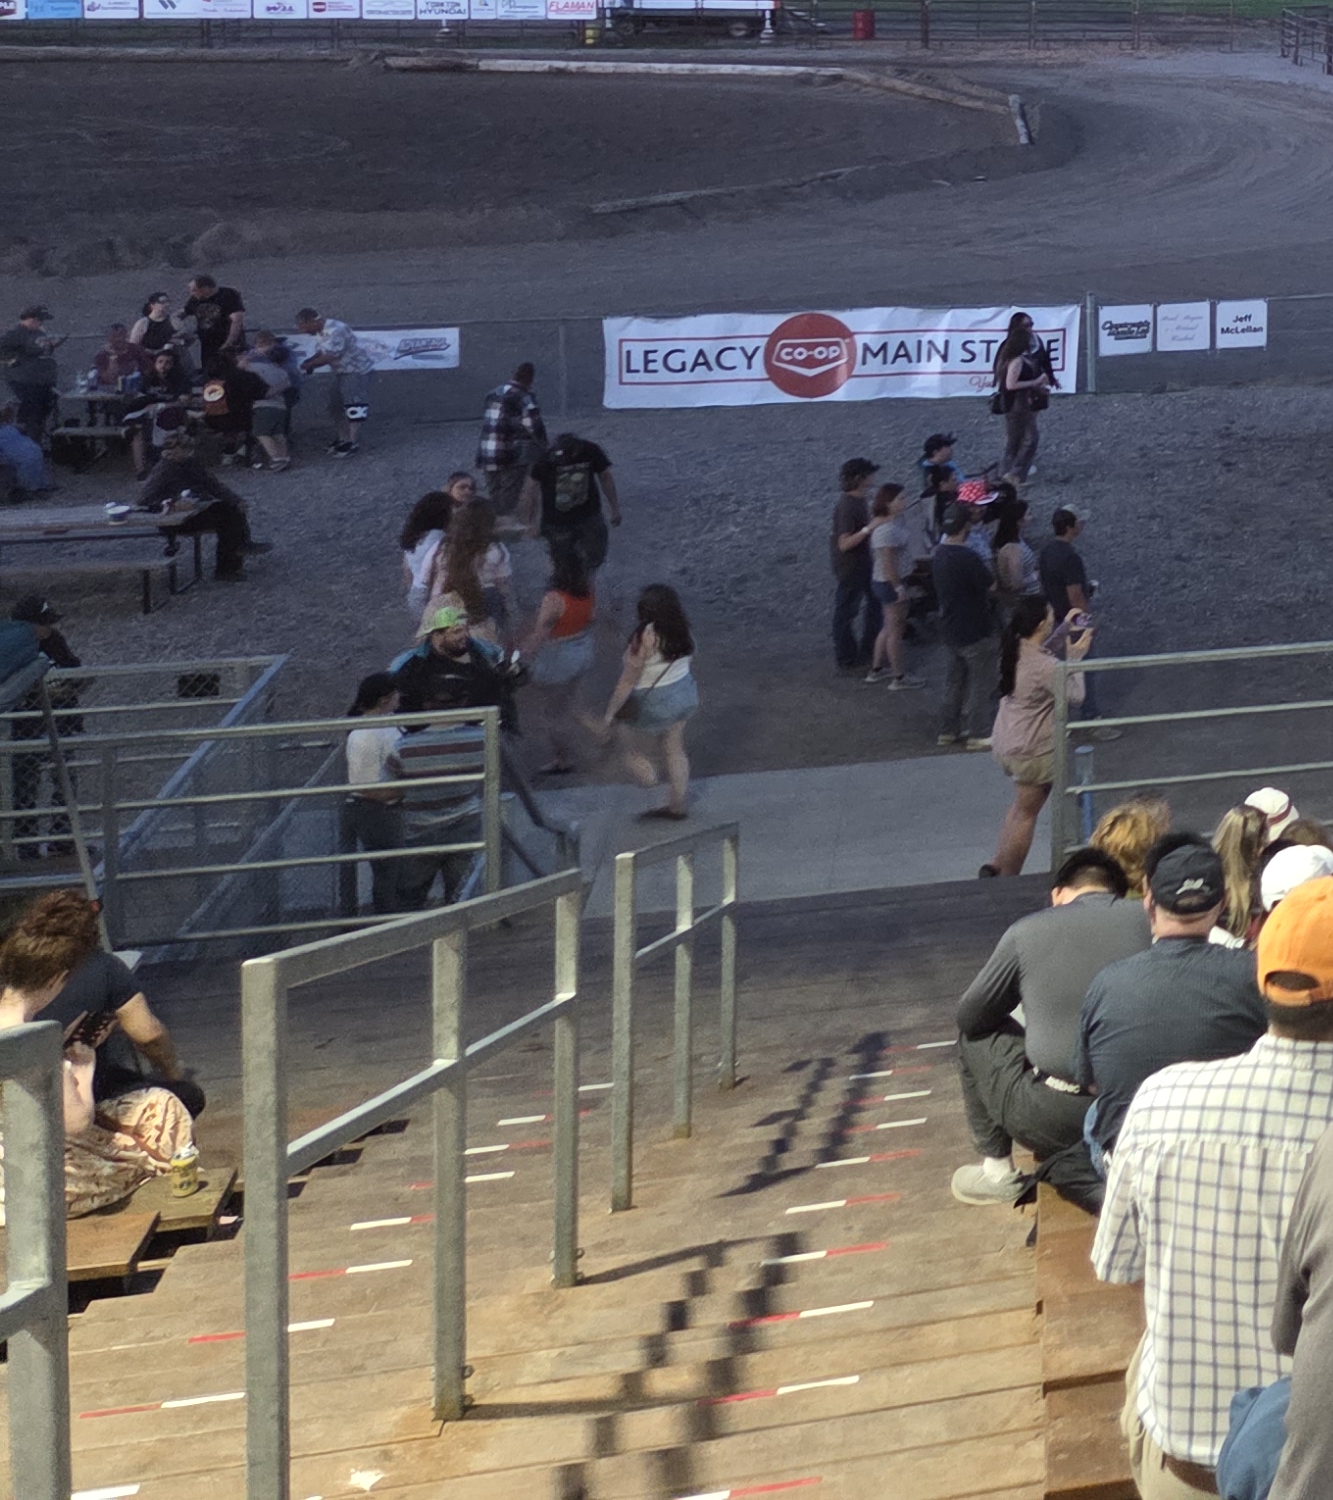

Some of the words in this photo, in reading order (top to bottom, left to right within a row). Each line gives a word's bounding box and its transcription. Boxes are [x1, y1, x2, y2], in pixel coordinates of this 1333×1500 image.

[549, 1, 595, 10] FLAMAN
[1232, 314, 1252, 324] Jeff
[1220, 325, 1264, 335] McLellan
[625, 345, 762, 374] LEGACY
[780, 345, 841, 362] CO-OP
[861, 339, 950, 366] MAIN
[960, 337, 1060, 363] STE
